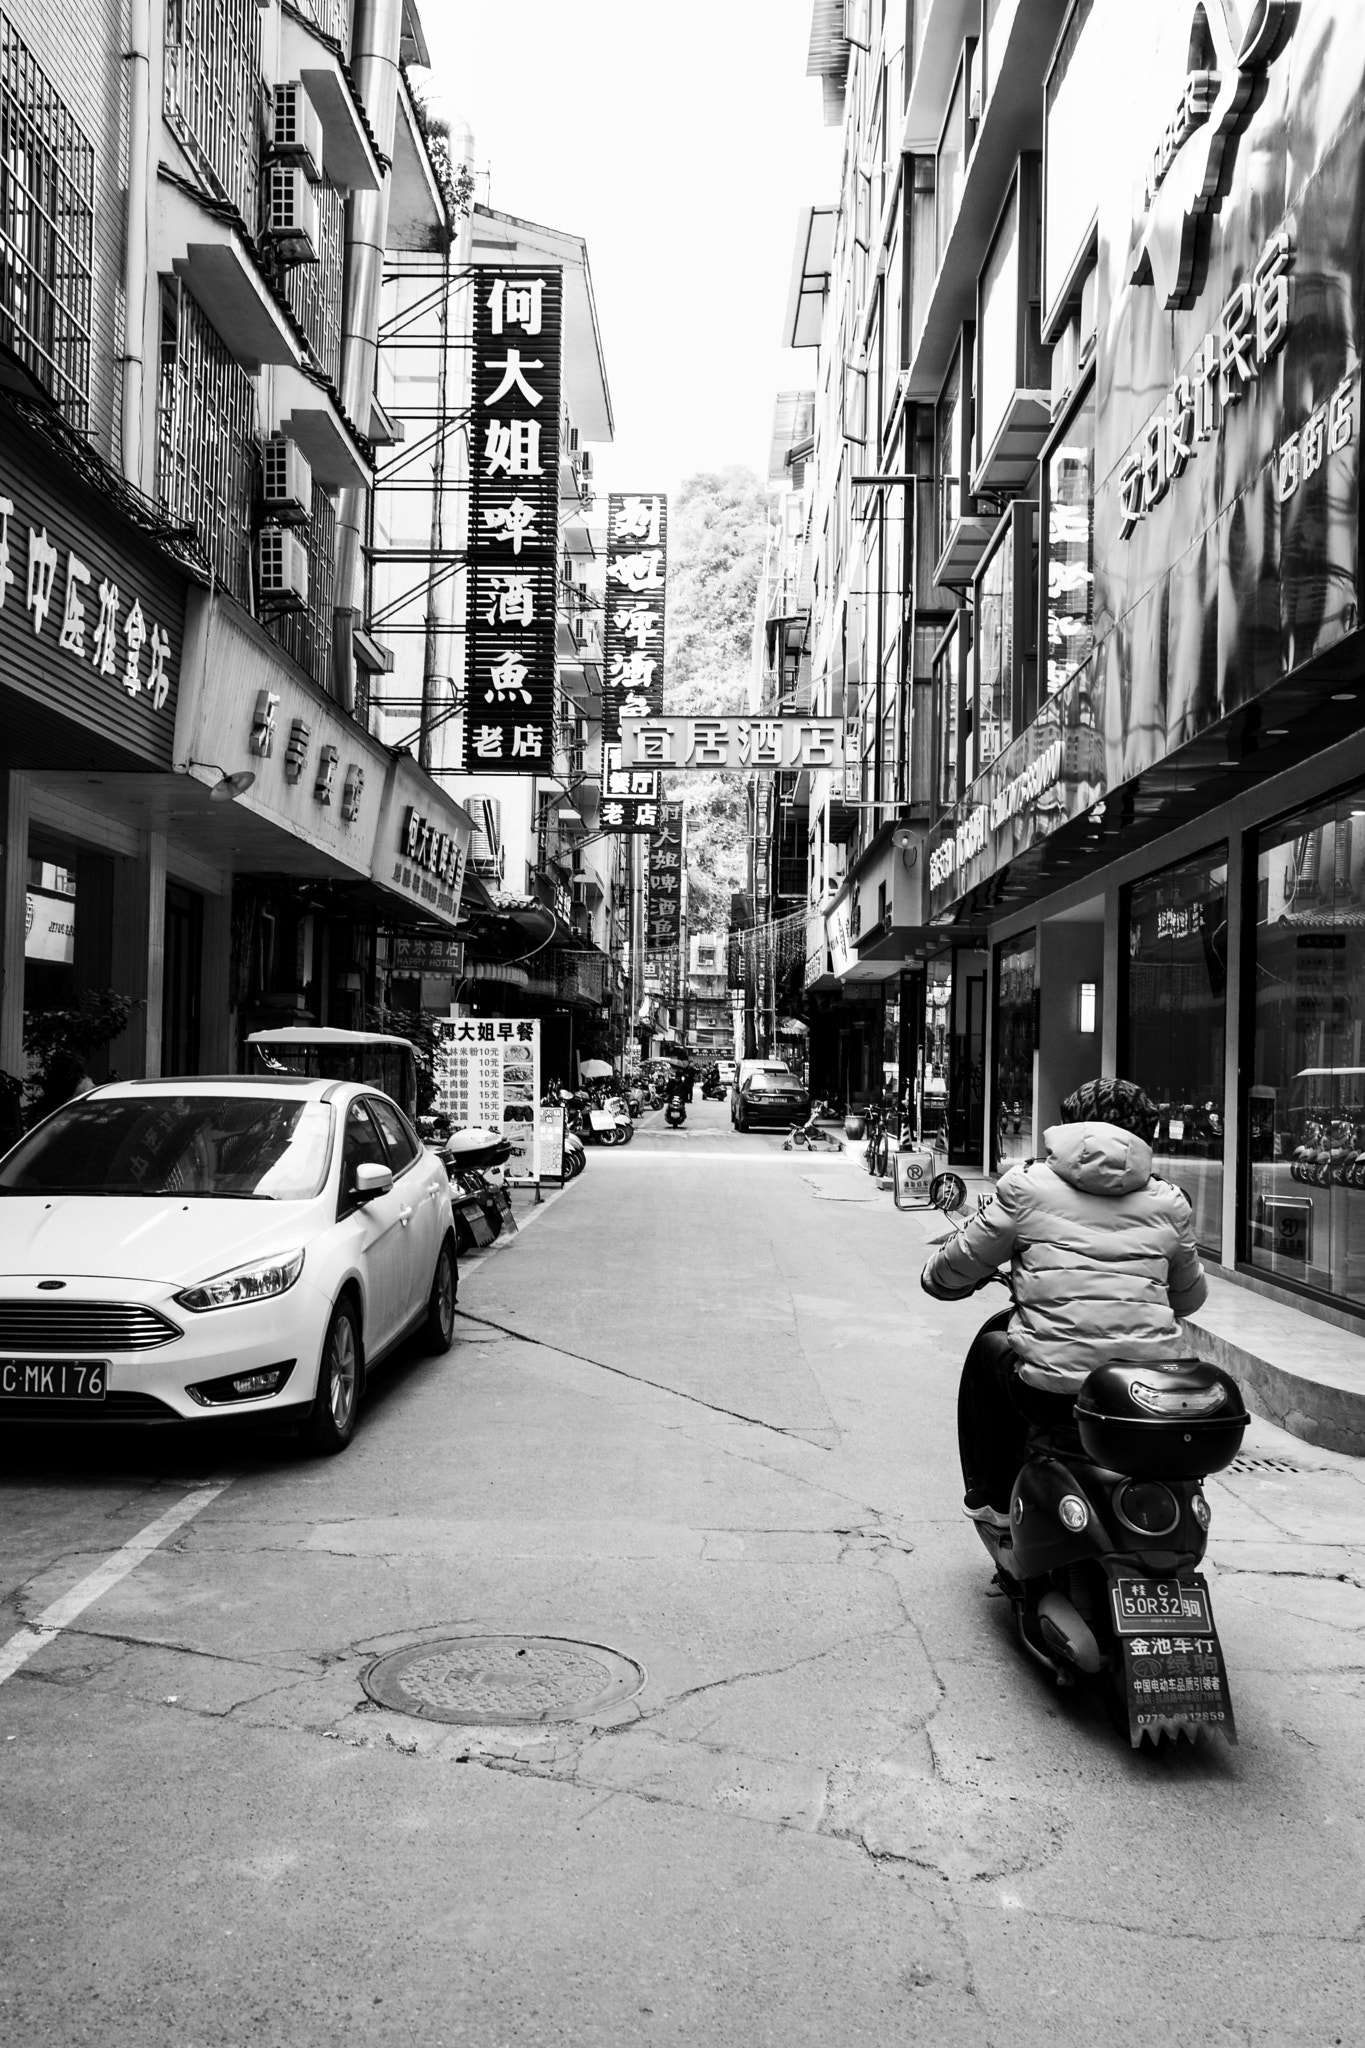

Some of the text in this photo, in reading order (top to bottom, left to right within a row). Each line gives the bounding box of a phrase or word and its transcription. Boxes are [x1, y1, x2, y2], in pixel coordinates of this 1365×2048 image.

[1279, 379, 1353, 502] 西街店
[471, 723, 544, 758] 老店
[632, 718, 836, 765] 宜居酒店
[609, 772, 653, 794] 餐厅
[602, 802, 657, 826] 老店
[397, 957, 459, 968] HAPPY HOTEL
[440, 1047, 499, 1057] 林米粉 10元
[480, 1058, 499, 1067] 10元
[480, 1069, 499, 1078] 10元
[440, 1080, 499, 1089] 牛肉粉 15元
[480, 1091, 499, 1100] 15元
[480, 1102, 499, 1111] 15元
[480, 1112, 499, 1121] 15元
[1131, 1584, 1169, 1597] 桂 C
[1125, 1598, 1181, 1614] 50R32
[1129, 1637, 1214, 1656] 金池车行
[1166, 1653, 1219, 1675] 绿驹
[1133, 1676, 1220, 1693] 中国电动车品质引领者
